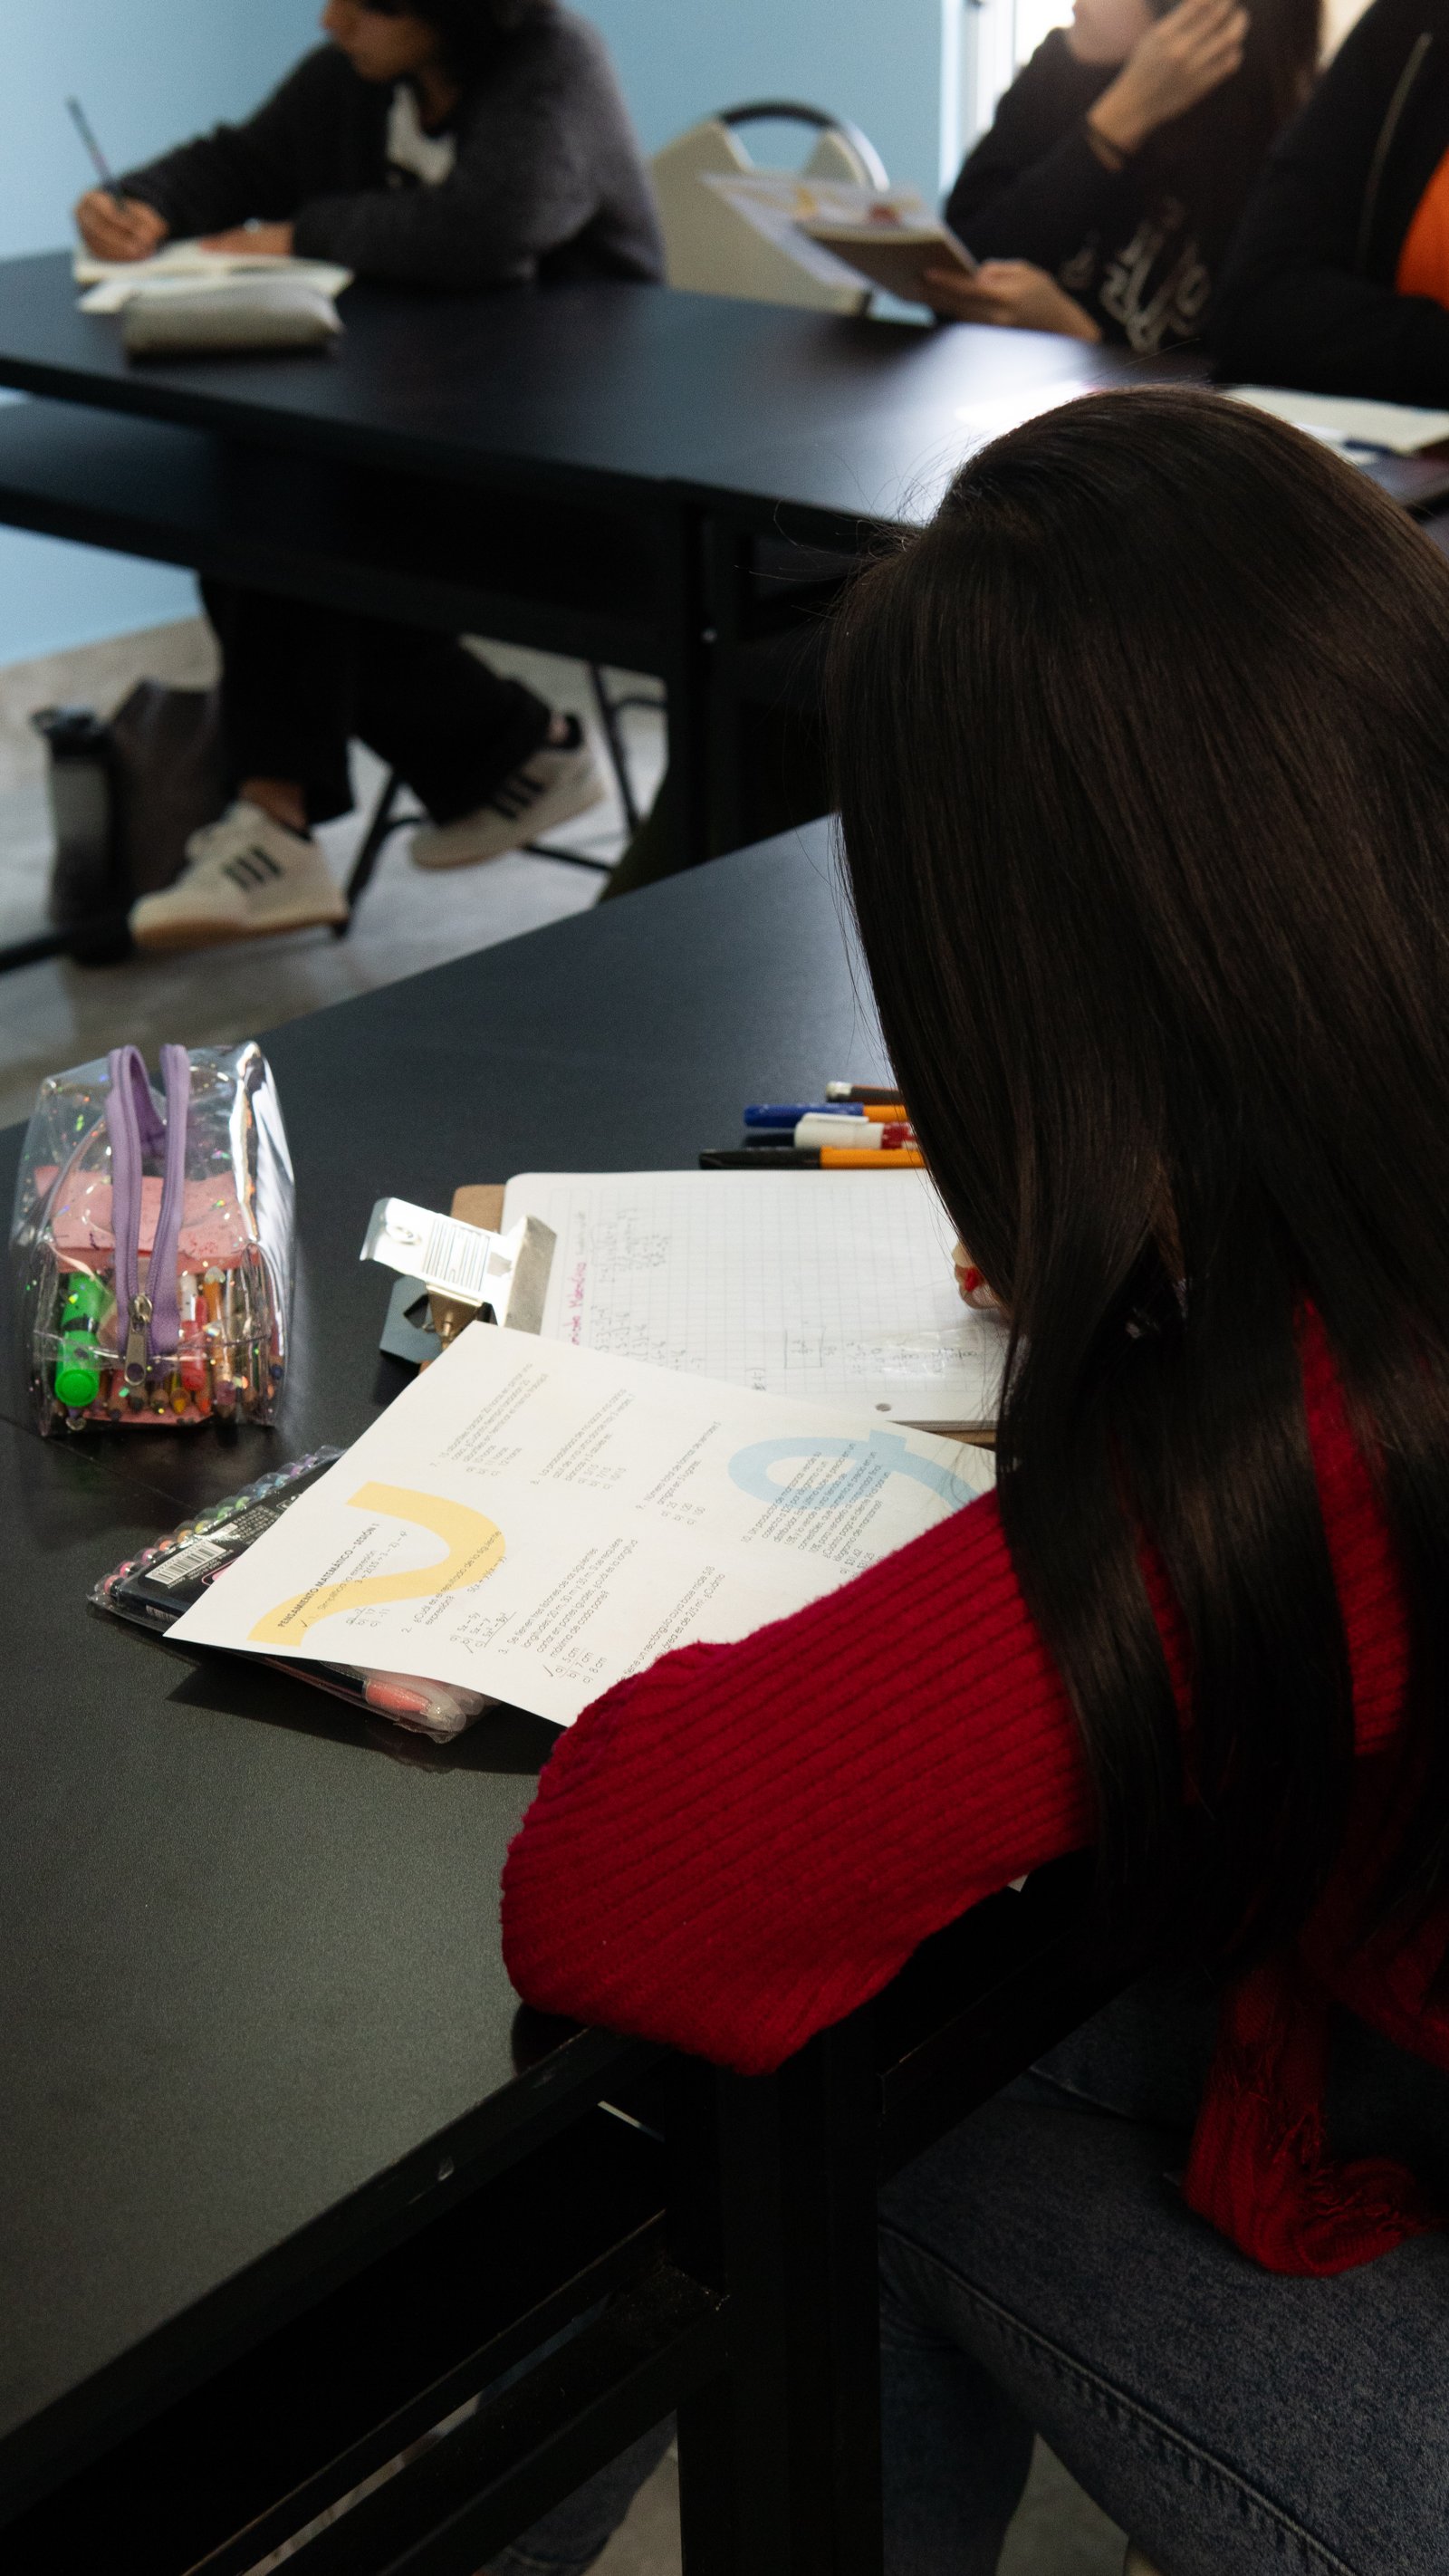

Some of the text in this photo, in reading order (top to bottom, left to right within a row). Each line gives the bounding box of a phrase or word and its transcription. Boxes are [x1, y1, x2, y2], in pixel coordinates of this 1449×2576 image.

[276, 1587, 321, 1628] PENSAMIENTO
[314, 1549, 354, 1588] MATEMÁTICO
[351, 1526, 377, 1546] SESIÓN
[348, 1550, 377, 1576] expresión
[423, 1595, 456, 1626] expresión?
[505, 1636, 521, 1645] Se
[513, 1618, 534, 1637] tienen
[530, 1607, 546, 1619] tres
[538, 1588, 562, 1609] listones
[557, 1580, 570, 1590] de
[565, 1572, 577, 1581] las
[571, 1547, 600, 1574] siguientes
[534, 1634, 556, 1653] cortar
[551, 1626, 562, 1635] en
[558, 1608, 579, 1628] partes
[591, 1572, 611, 1590] ¿cuál
[604, 1565, 616, 1573] es
[616, 1538, 640, 1562] longitud
[548, 1590, 610, 1658] máxima de cada parte?
[560, 1656, 573, 1664] 5
[567, 1647, 581, 1658] cm
[581, 1651, 594, 1663] cm
[594, 1656, 608, 1668] cm
